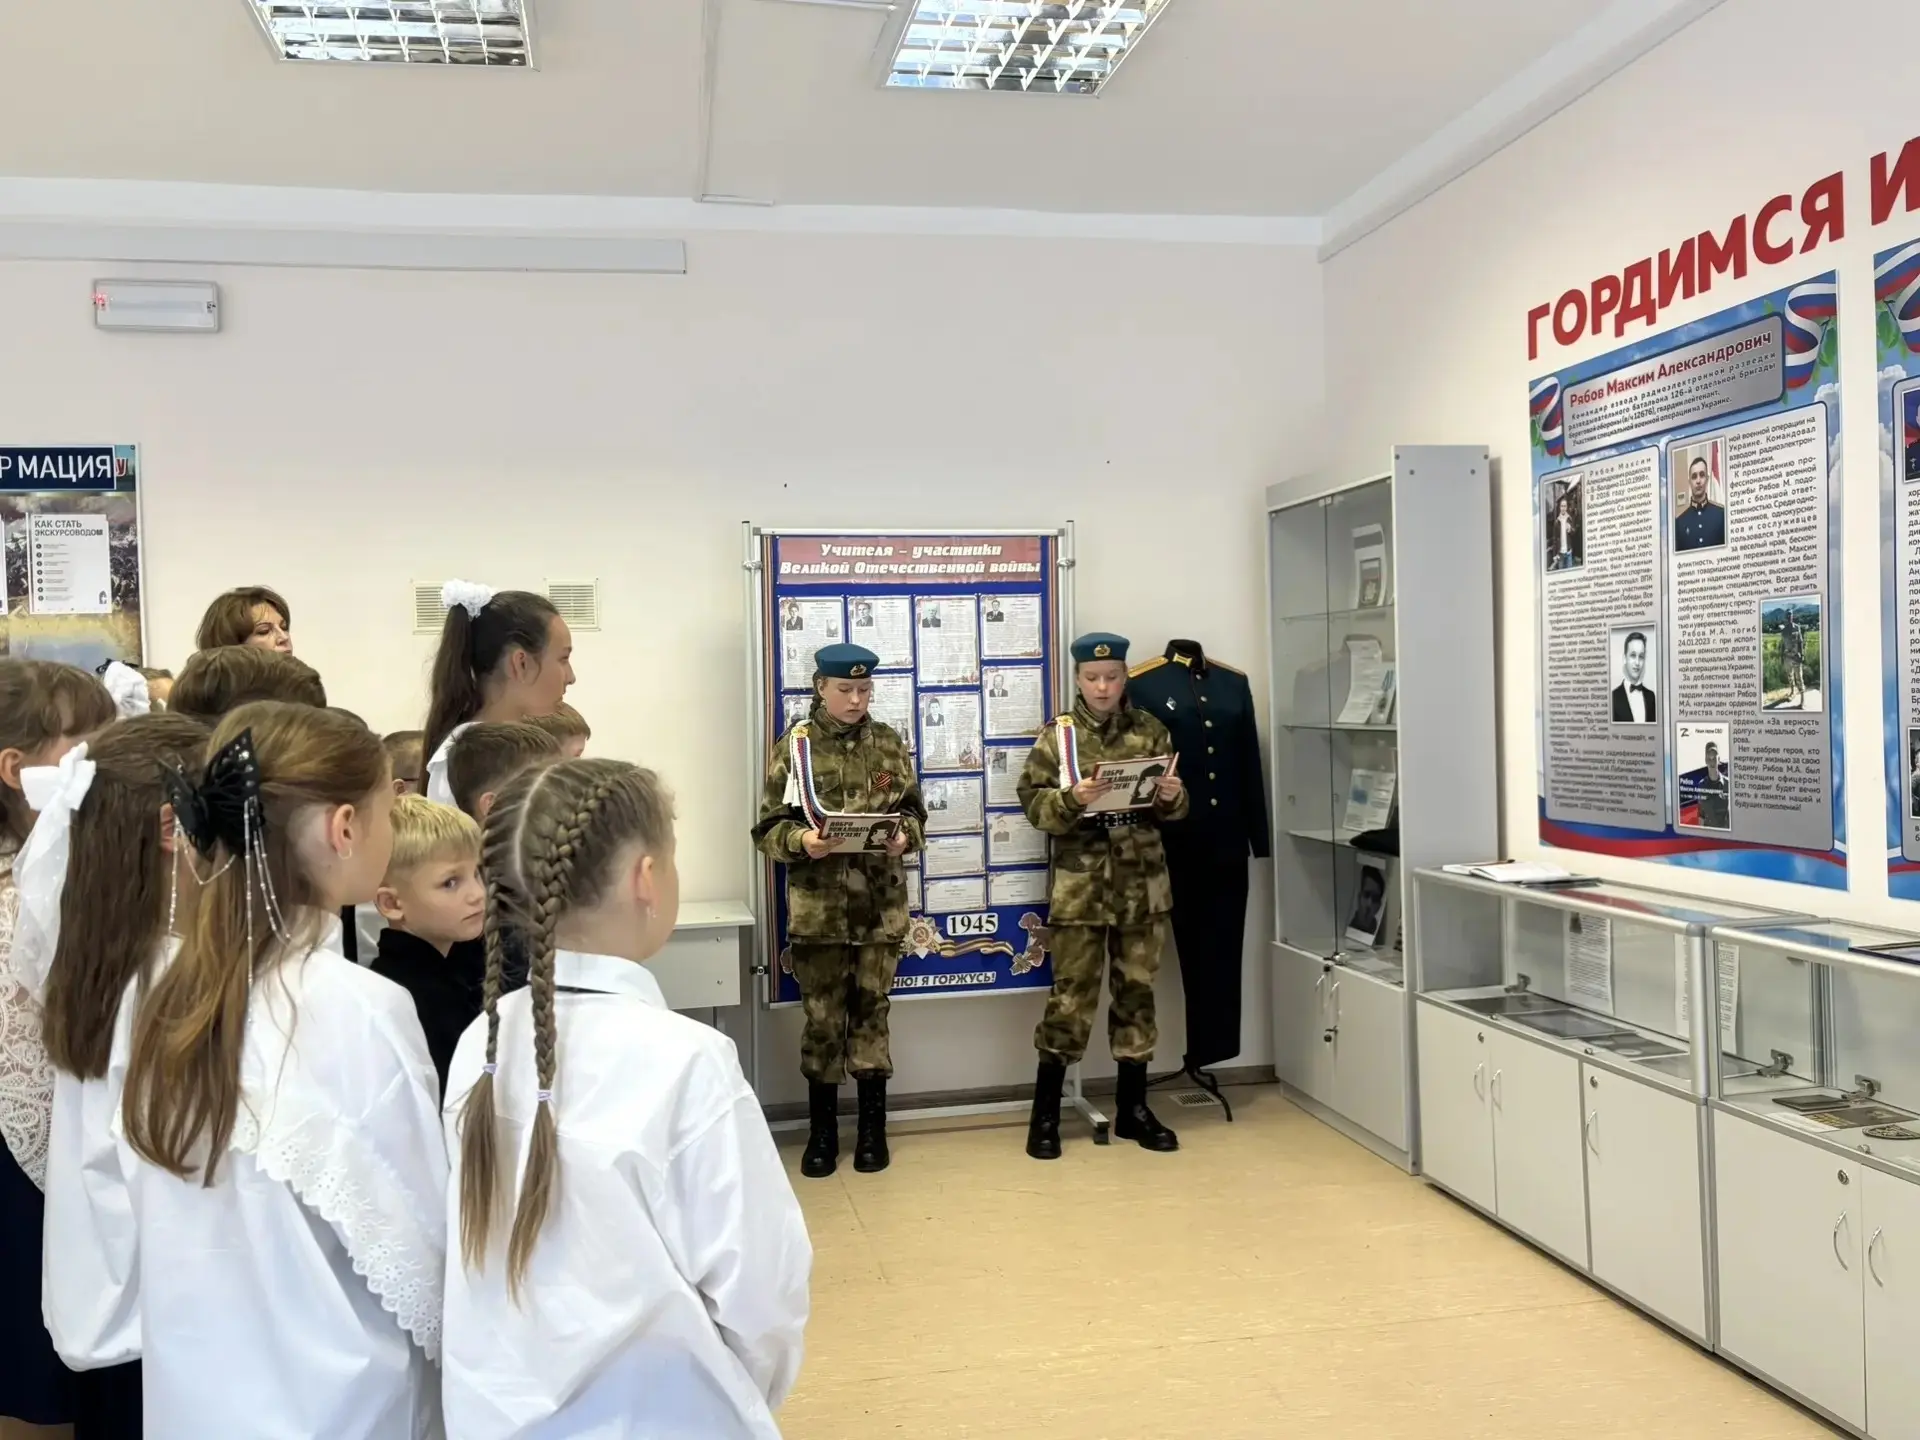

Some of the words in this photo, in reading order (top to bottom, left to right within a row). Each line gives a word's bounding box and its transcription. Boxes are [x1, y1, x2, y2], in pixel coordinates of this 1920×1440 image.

[1528, 171, 1844, 361] ГОРДИМСЯ
[1870, 134, 1920, 226] И
[1570, 387, 1605, 408] Рябов
[1606, 370, 1656, 397] Максим
[1657, 331, 1772, 380] Александрович
[1571, 403, 1607, 420] Командир
[1641, 366, 1724, 400] радиоэлектронной
[1729, 352, 1775, 373] разведки
[1632, 394, 1668, 411] батальона
[1670, 385, 1692, 399] 126-й
[1695, 372, 1735, 391] отдельной
[1739, 361, 1775, 378] бригады
[1728, 432, 1740, 442] ной
[1741, 425, 1769, 439] военной
[1770, 419, 1805, 432] операции
[1805, 416, 1815, 424] на
[1728, 439, 1762, 451] Украине.
[1765, 426, 1816, 443] Командовал
[1728, 449, 1756, 460] взводом
[1758, 437, 1815, 456] радиоэлектрон-
[18, 455, 112, 482] МАЦИЯ
[1729, 460, 1741, 470] ной
[1734, 470, 1739, 478] К
[1742, 460, 1795, 477] прохождению
[1797, 456, 1816, 466] про-
[1729, 470, 1782, 490] фессиональной
[1785, 464, 1816, 477] военной
[1729, 486, 1755, 496] службы
[1758, 482, 1780, 491] Рябов
[1794, 476, 1816, 484] подо-
[1729, 498, 1744, 506] шел
[1754, 489, 1788, 502] большой
[1791, 486, 1816, 496] ответ-
[1773, 498, 1795, 509] Среди
[1796, 495, 1817, 505] одно-
[1771, 505, 1816, 519] однокурсни-
[34, 520, 52, 528] КАК
[55, 520, 82, 528] СТАТЬ
[1730, 525, 1744, 533] ков
[1757, 514, 1817, 529] сослуживцев
[34, 529, 103, 537] ЭКСКУРСОВОДОМ
[1730, 530, 1773, 543] пользовался
[1775, 524, 1817, 538] уважением
[1739, 539, 1767, 551] веселый
[1788, 534, 1816, 544] бескон-
[820, 543, 893, 557] Учителя
[912, 543, 1002, 559] участники
[1716, 554, 1740, 565] умение
[1788, 544, 1817, 554] Максим
[780, 561, 850, 574] Великой
[854, 561, 985, 574] Отечественной
[990, 561, 1041, 573] войны
[1696, 563, 1740, 574] товарищеские
[1742, 559, 1779, 568] отношения
[1676, 577, 1699, 586] верным
[1706, 573, 1740, 583] надежным
[1768, 564, 1816, 575] высококвали-
[1677, 583, 1723, 595] фицированным
[1775, 575, 1799, 583] Всегда
[1802, 572, 1817, 580] был
[1789, 583, 1817, 593] решить
[1698, 602, 1728, 611] проблему
[1733, 599, 1755, 608] прису-
[1706, 609, 1756, 618] ответственнос-
[1681, 629, 1705, 637] Рябов
[1709, 627, 1727, 635] М.А.
[1731, 624, 1756, 634] погиб
[1719, 637, 1731, 645] при
[1730, 645, 1750, 653] долга
[1694, 654, 1734, 663] специальной
[1689, 665, 1718, 673] операции
[1727, 663, 1755, 671] Украине.
[1692, 673, 1729, 682] доблестное
[1736, 689, 1757, 697] Рябов
[1728, 700, 1757, 708] орденом
[1678, 708, 1712, 717] Мужества
[1715, 709, 1756, 717] посмертно,
[1767, 717, 1780, 725] «За
[1732, 728, 1755, 736] долгу»
[1764, 728, 1795, 736] медалью
[1798, 727, 1819, 736] Суво-
[1737, 744, 1749, 752] Нет
[1752, 745, 1780, 754] храбрее
[1733, 755, 1762, 763] жертвует
[1733, 762, 1759, 772] Родину.
[1762, 763, 1783, 772] Рябов
[1805, 765, 1820, 773] был
[1733, 773, 1774, 782] настоящим
[1777, 774, 1820, 784] офицером!
[1734, 780, 1745, 789] Его
[1748, 783, 1772, 791] подвиг
[1775, 783, 1795, 793] будет
[1734, 799, 1761, 809] будущих
[1788, 794, 1812, 802] нашей
[949, 914, 996, 934] 1945
[921, 976, 929, 985] Я
[932, 972, 995, 985] ГОРЖУСЬ!
